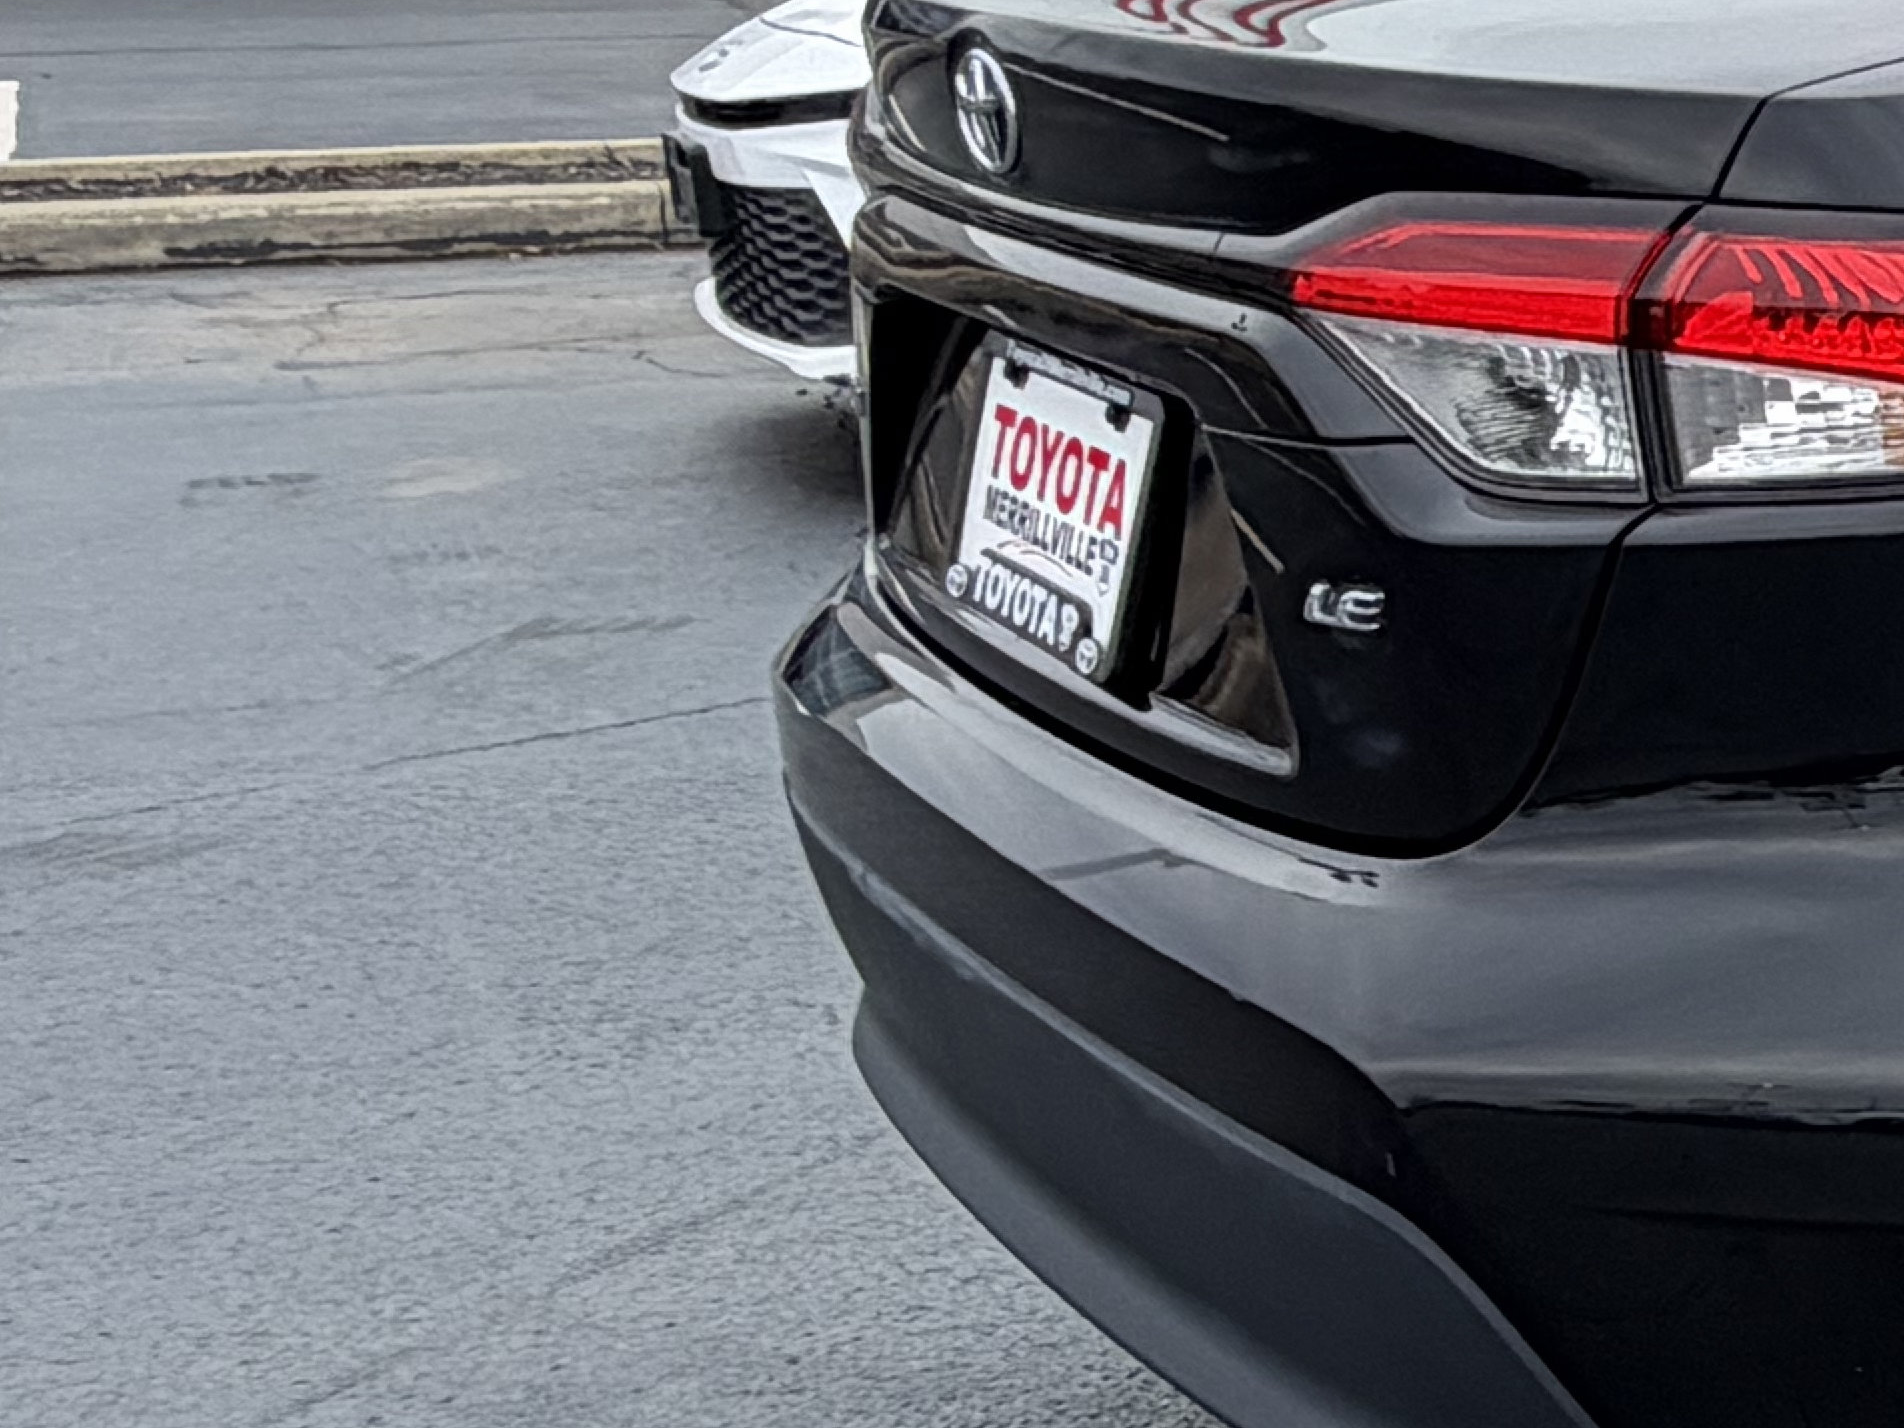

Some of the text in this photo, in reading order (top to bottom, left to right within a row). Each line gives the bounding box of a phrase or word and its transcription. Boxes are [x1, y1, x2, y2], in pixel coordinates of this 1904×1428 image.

[991, 403, 1128, 542] TOYOTA
[982, 484, 1098, 577] MERRILLVILLE
[973, 563, 1057, 647] TOYOTA
[1303, 581, 1385, 631] LE
